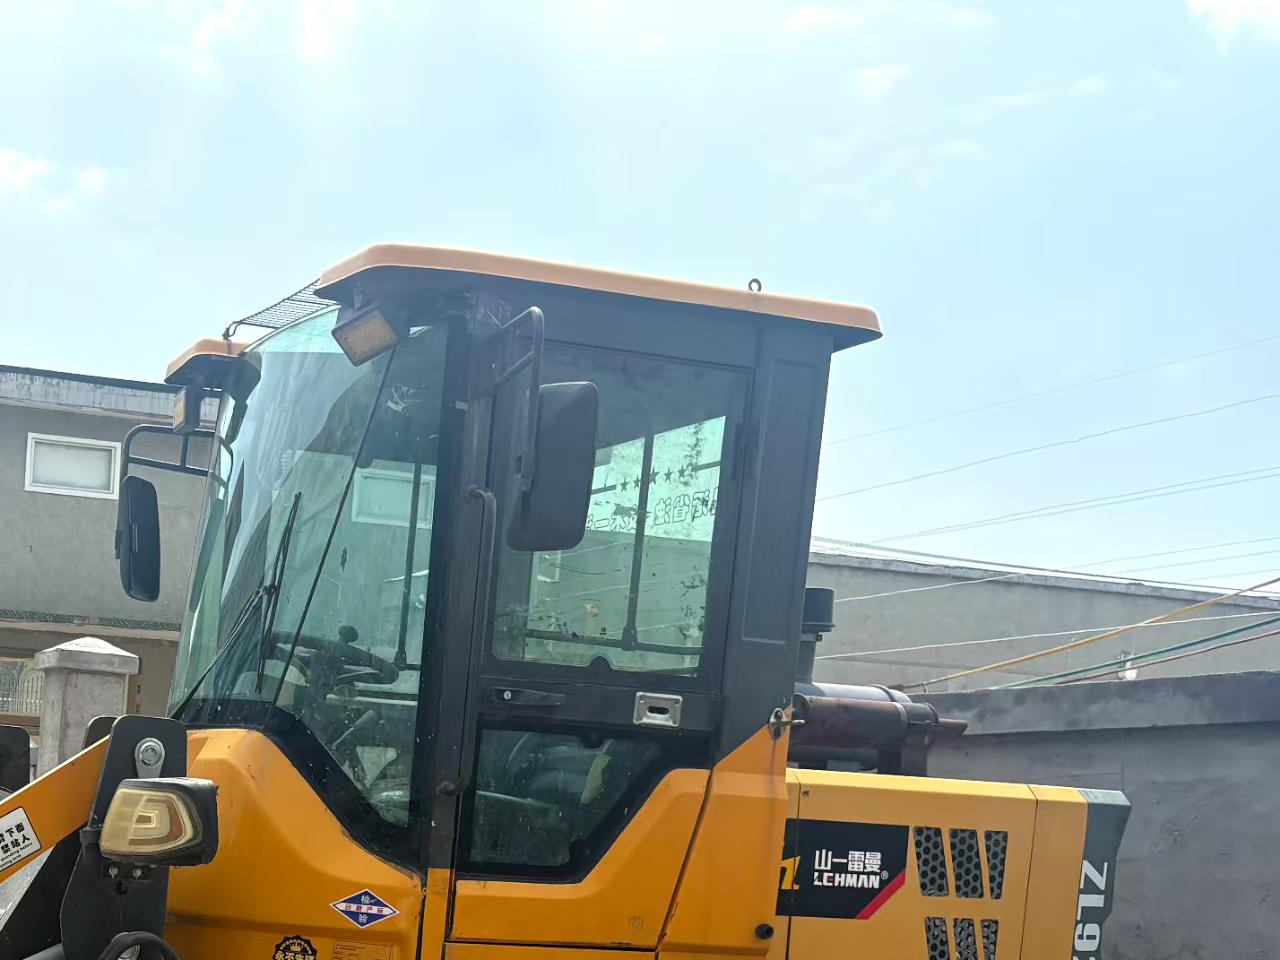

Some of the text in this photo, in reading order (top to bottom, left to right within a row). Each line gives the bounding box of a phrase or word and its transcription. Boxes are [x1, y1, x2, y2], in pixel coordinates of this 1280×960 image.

[814, 848, 882, 873] 山一雷曼
[813, 872, 881, 889] LEHMAN
